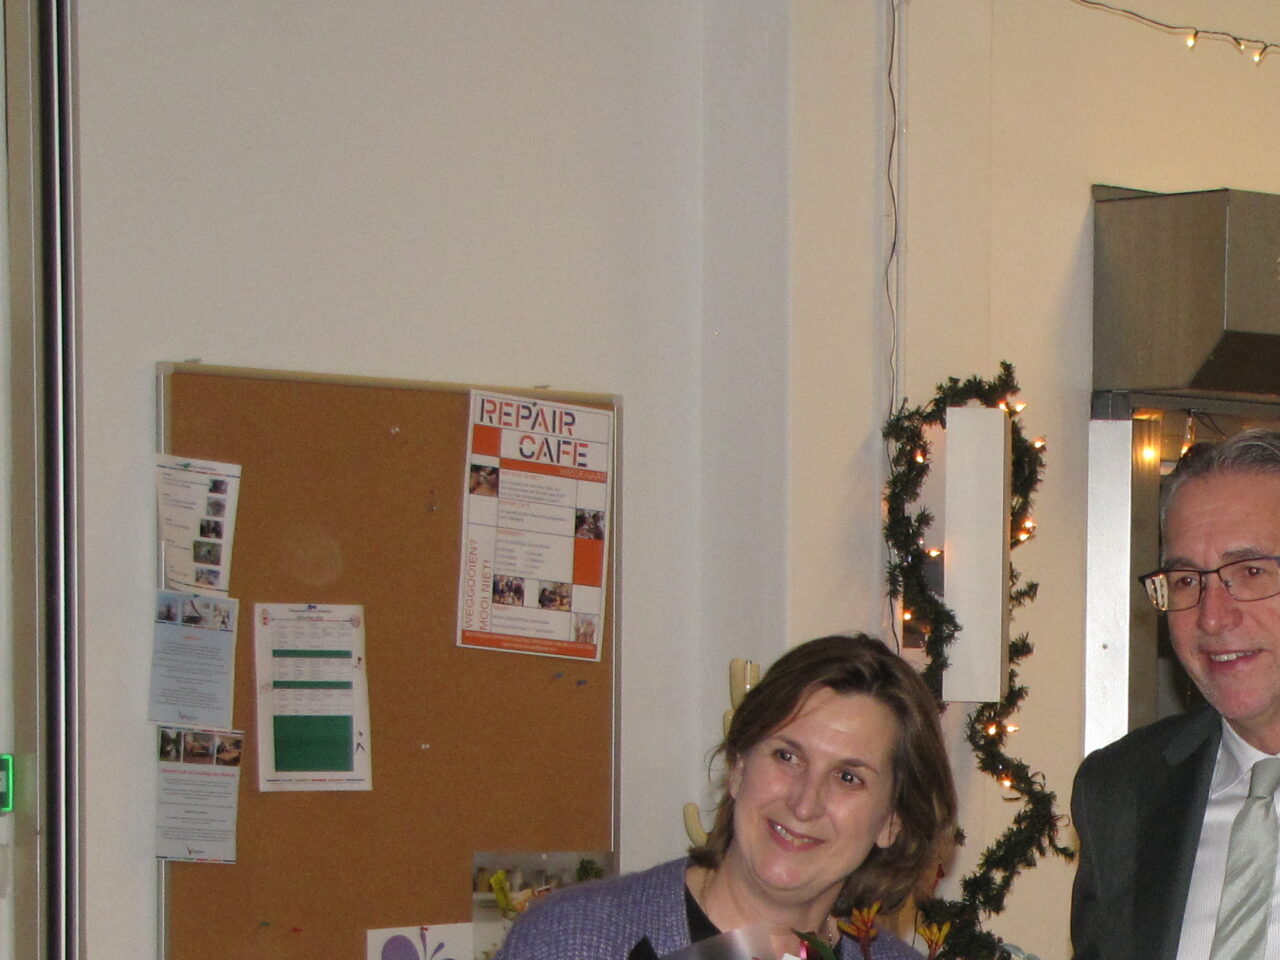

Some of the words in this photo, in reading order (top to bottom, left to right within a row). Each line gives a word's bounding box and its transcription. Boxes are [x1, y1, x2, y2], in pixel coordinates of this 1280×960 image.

[480, 397, 577, 436] REPAIR
[518, 434, 590, 468] CAFE
[464, 538, 480, 630] WEGGOOIEN?
[480, 596, 492, 631] MOOI
